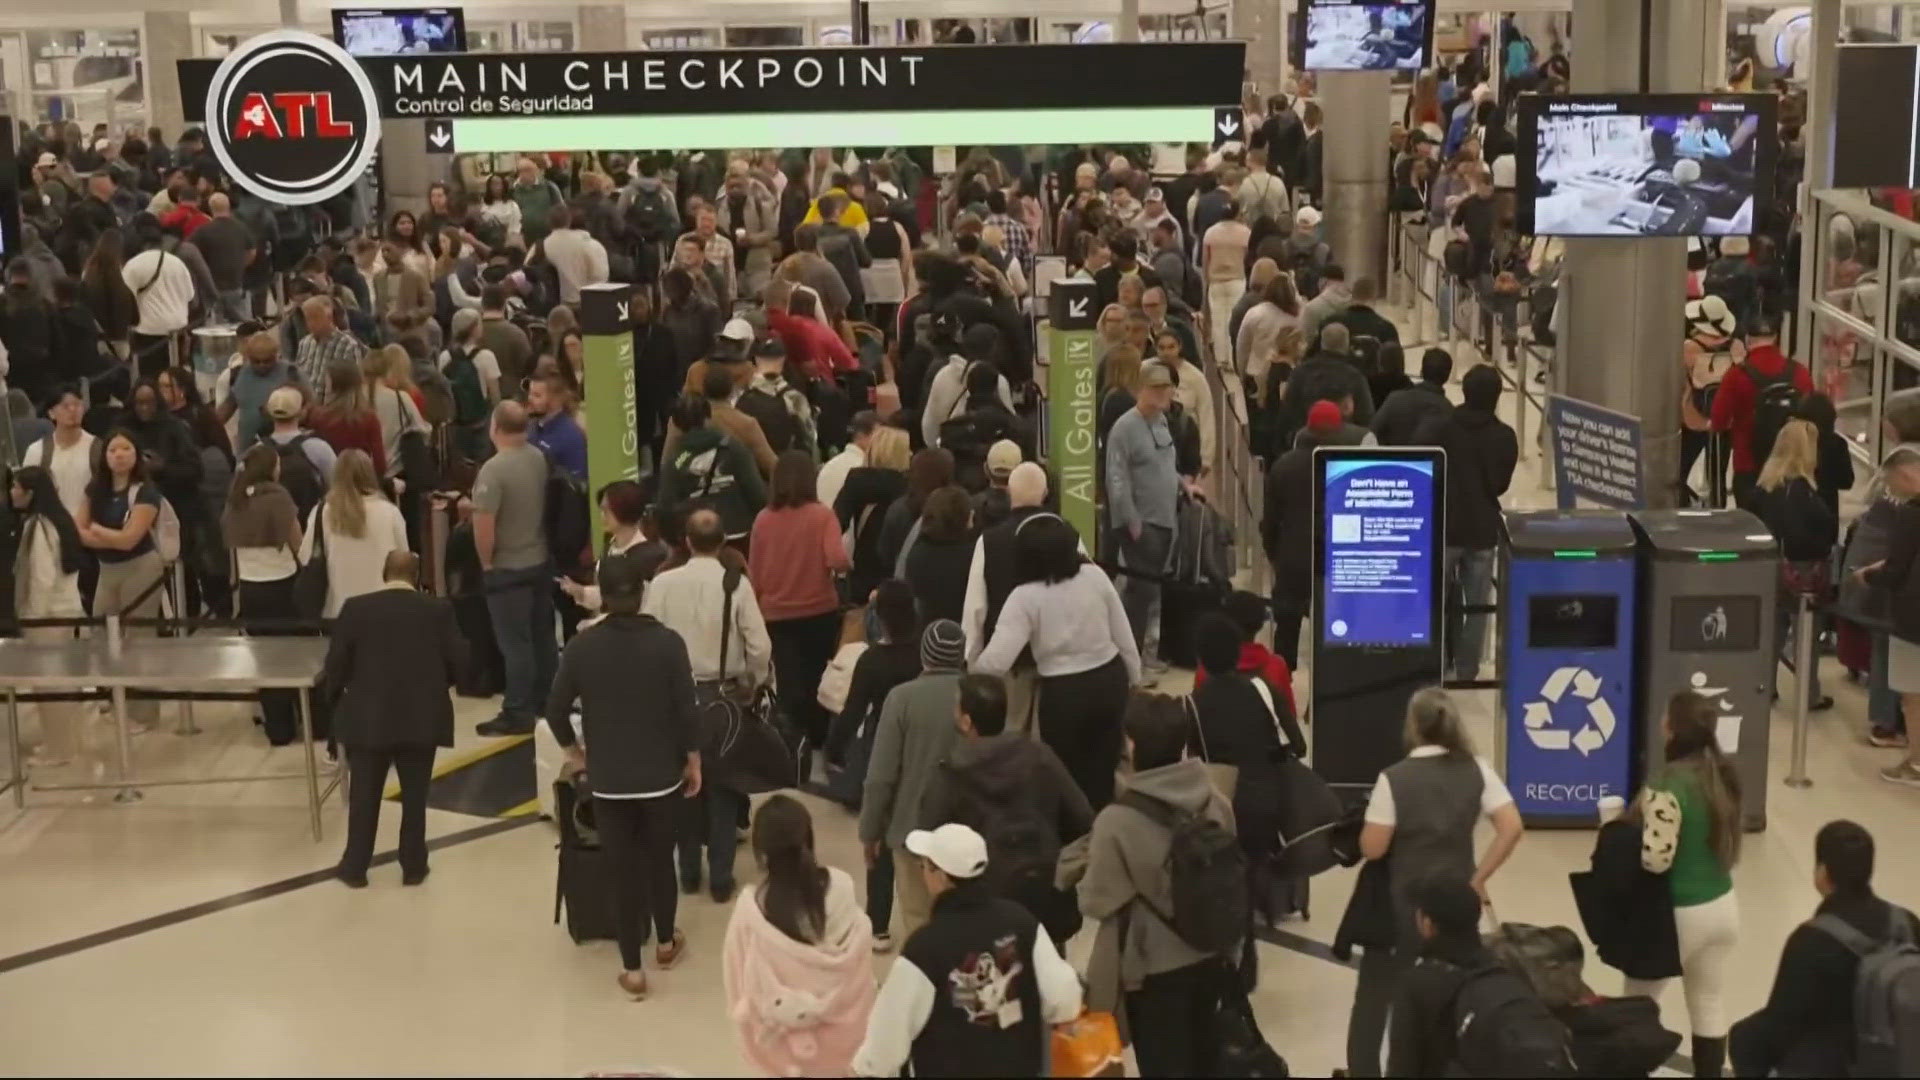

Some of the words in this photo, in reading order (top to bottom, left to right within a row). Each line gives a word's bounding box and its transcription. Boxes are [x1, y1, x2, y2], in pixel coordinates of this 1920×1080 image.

[393, 62, 528, 95] MAIN
[563, 55, 924, 91] CHECKPOINT
[233, 92, 354, 139] ATL
[395, 96, 464, 113] Control
[470, 96, 493, 113] de
[499, 94, 594, 115] Seguridad
[622, 368, 638, 456] Gates
[1065, 367, 1093, 455] Gates
[1581, 418, 1598, 432] you
[1614, 427, 1631, 441] add
[1064, 465, 1093, 502] All
[1526, 783, 1609, 801] RECYCLE
